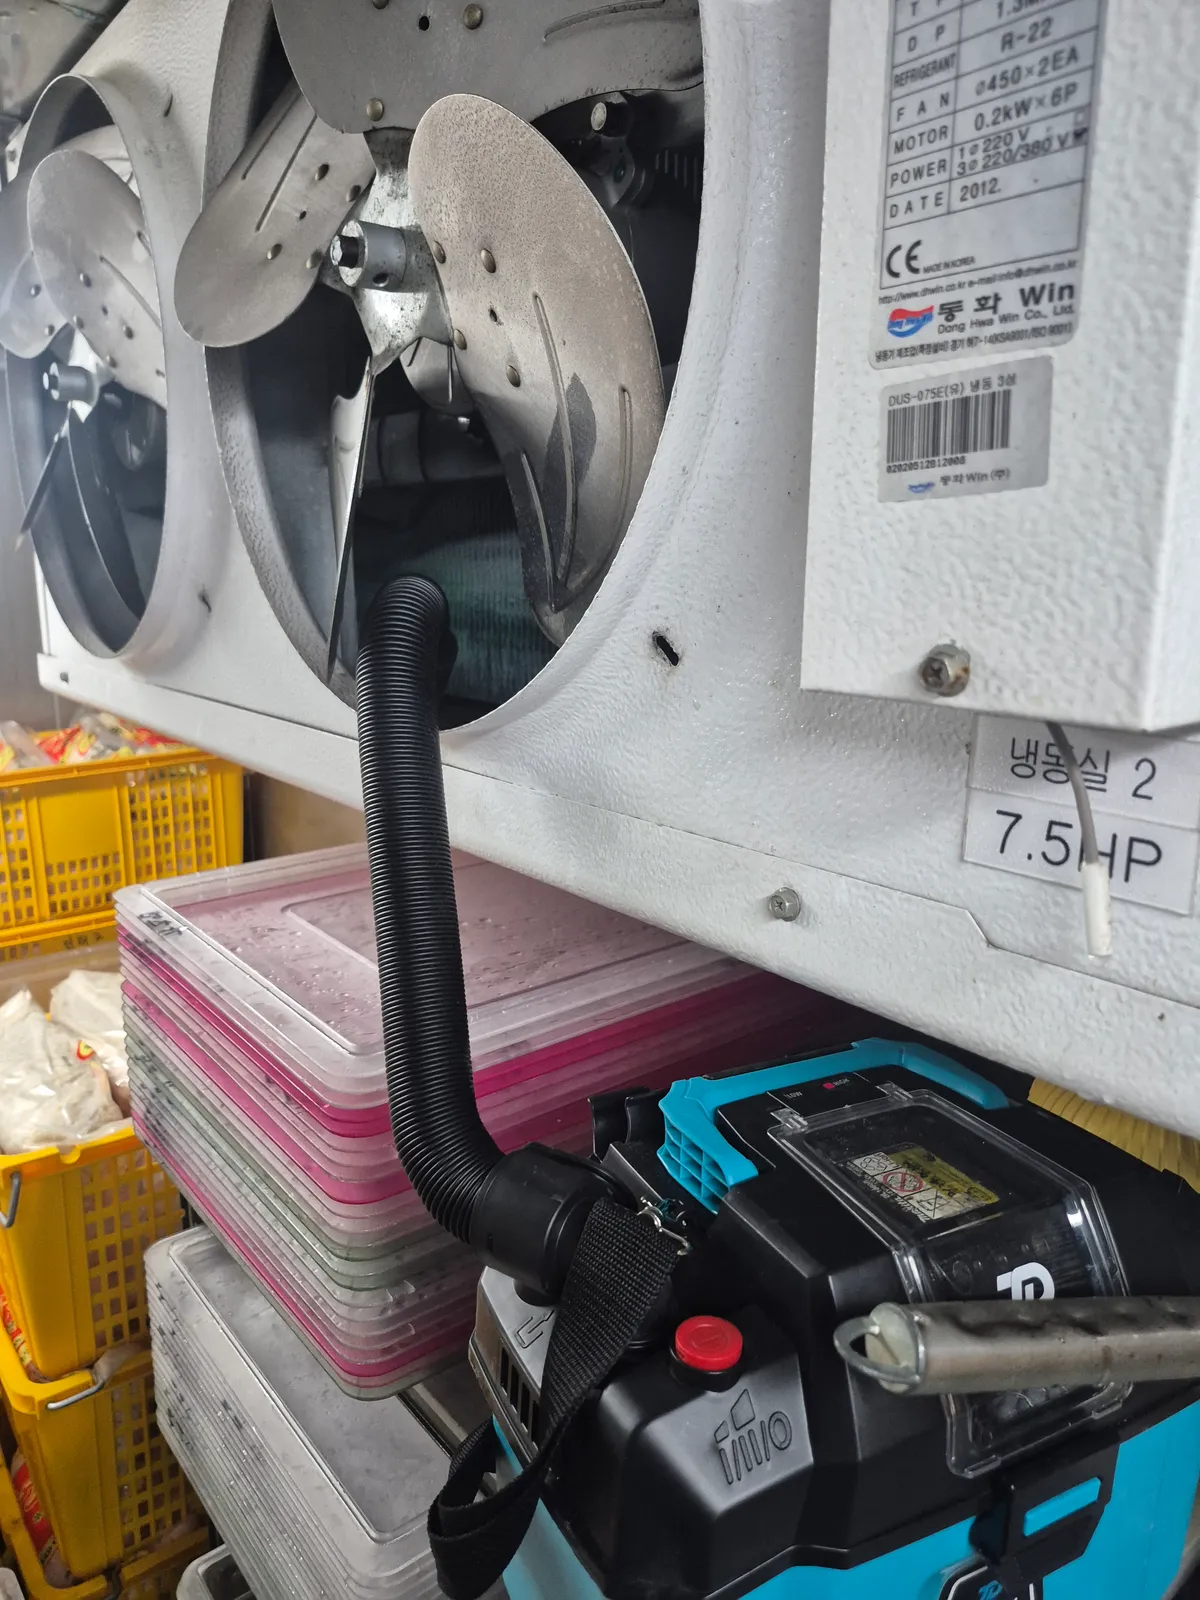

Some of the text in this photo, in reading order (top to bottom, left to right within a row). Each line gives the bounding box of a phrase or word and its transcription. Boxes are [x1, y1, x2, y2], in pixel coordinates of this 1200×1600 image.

[1001, 17, 1054, 53] R-22
[893, 52, 956, 89] REFRIGERANT
[893, 124, 949, 154] MOTOR
[890, 158, 948, 189] POWER
[889, 191, 944, 219] DATE
[1018, 282, 1075, 308] Win
[937, 322, 966, 335] Dong
[969, 318, 994, 329] Hwa
[998, 313, 1020, 324] Win
[969, 376, 993, 394] 냉동
[1010, 736, 1157, 801] 냉동실 2
[995, 808, 1163, 884] 7.5HP
